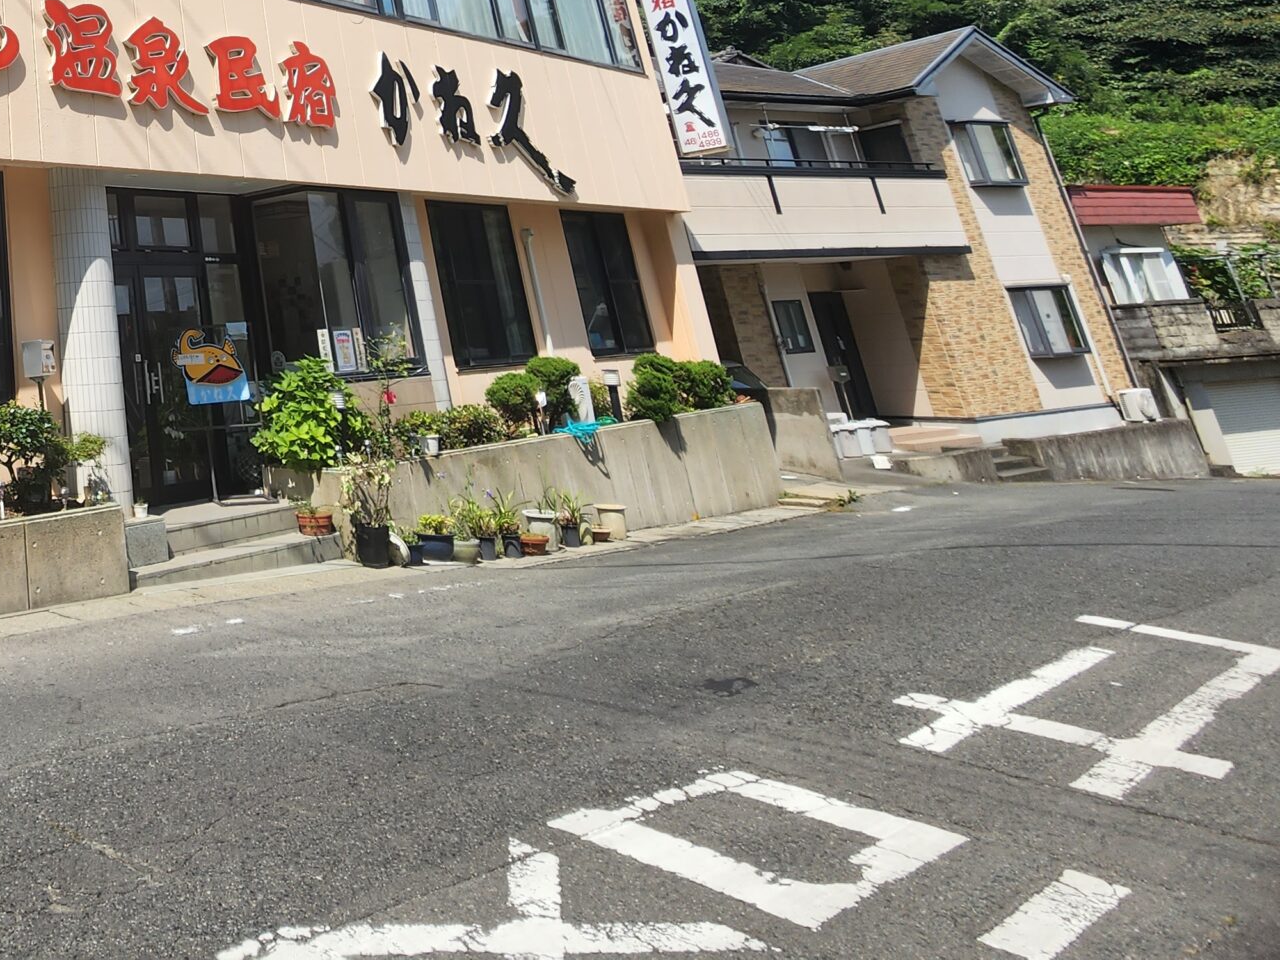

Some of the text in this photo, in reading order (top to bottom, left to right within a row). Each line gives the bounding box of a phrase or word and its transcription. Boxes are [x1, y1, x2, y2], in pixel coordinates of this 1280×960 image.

[367, 50, 577, 197] かね久
[655, 10, 716, 127] かね久
